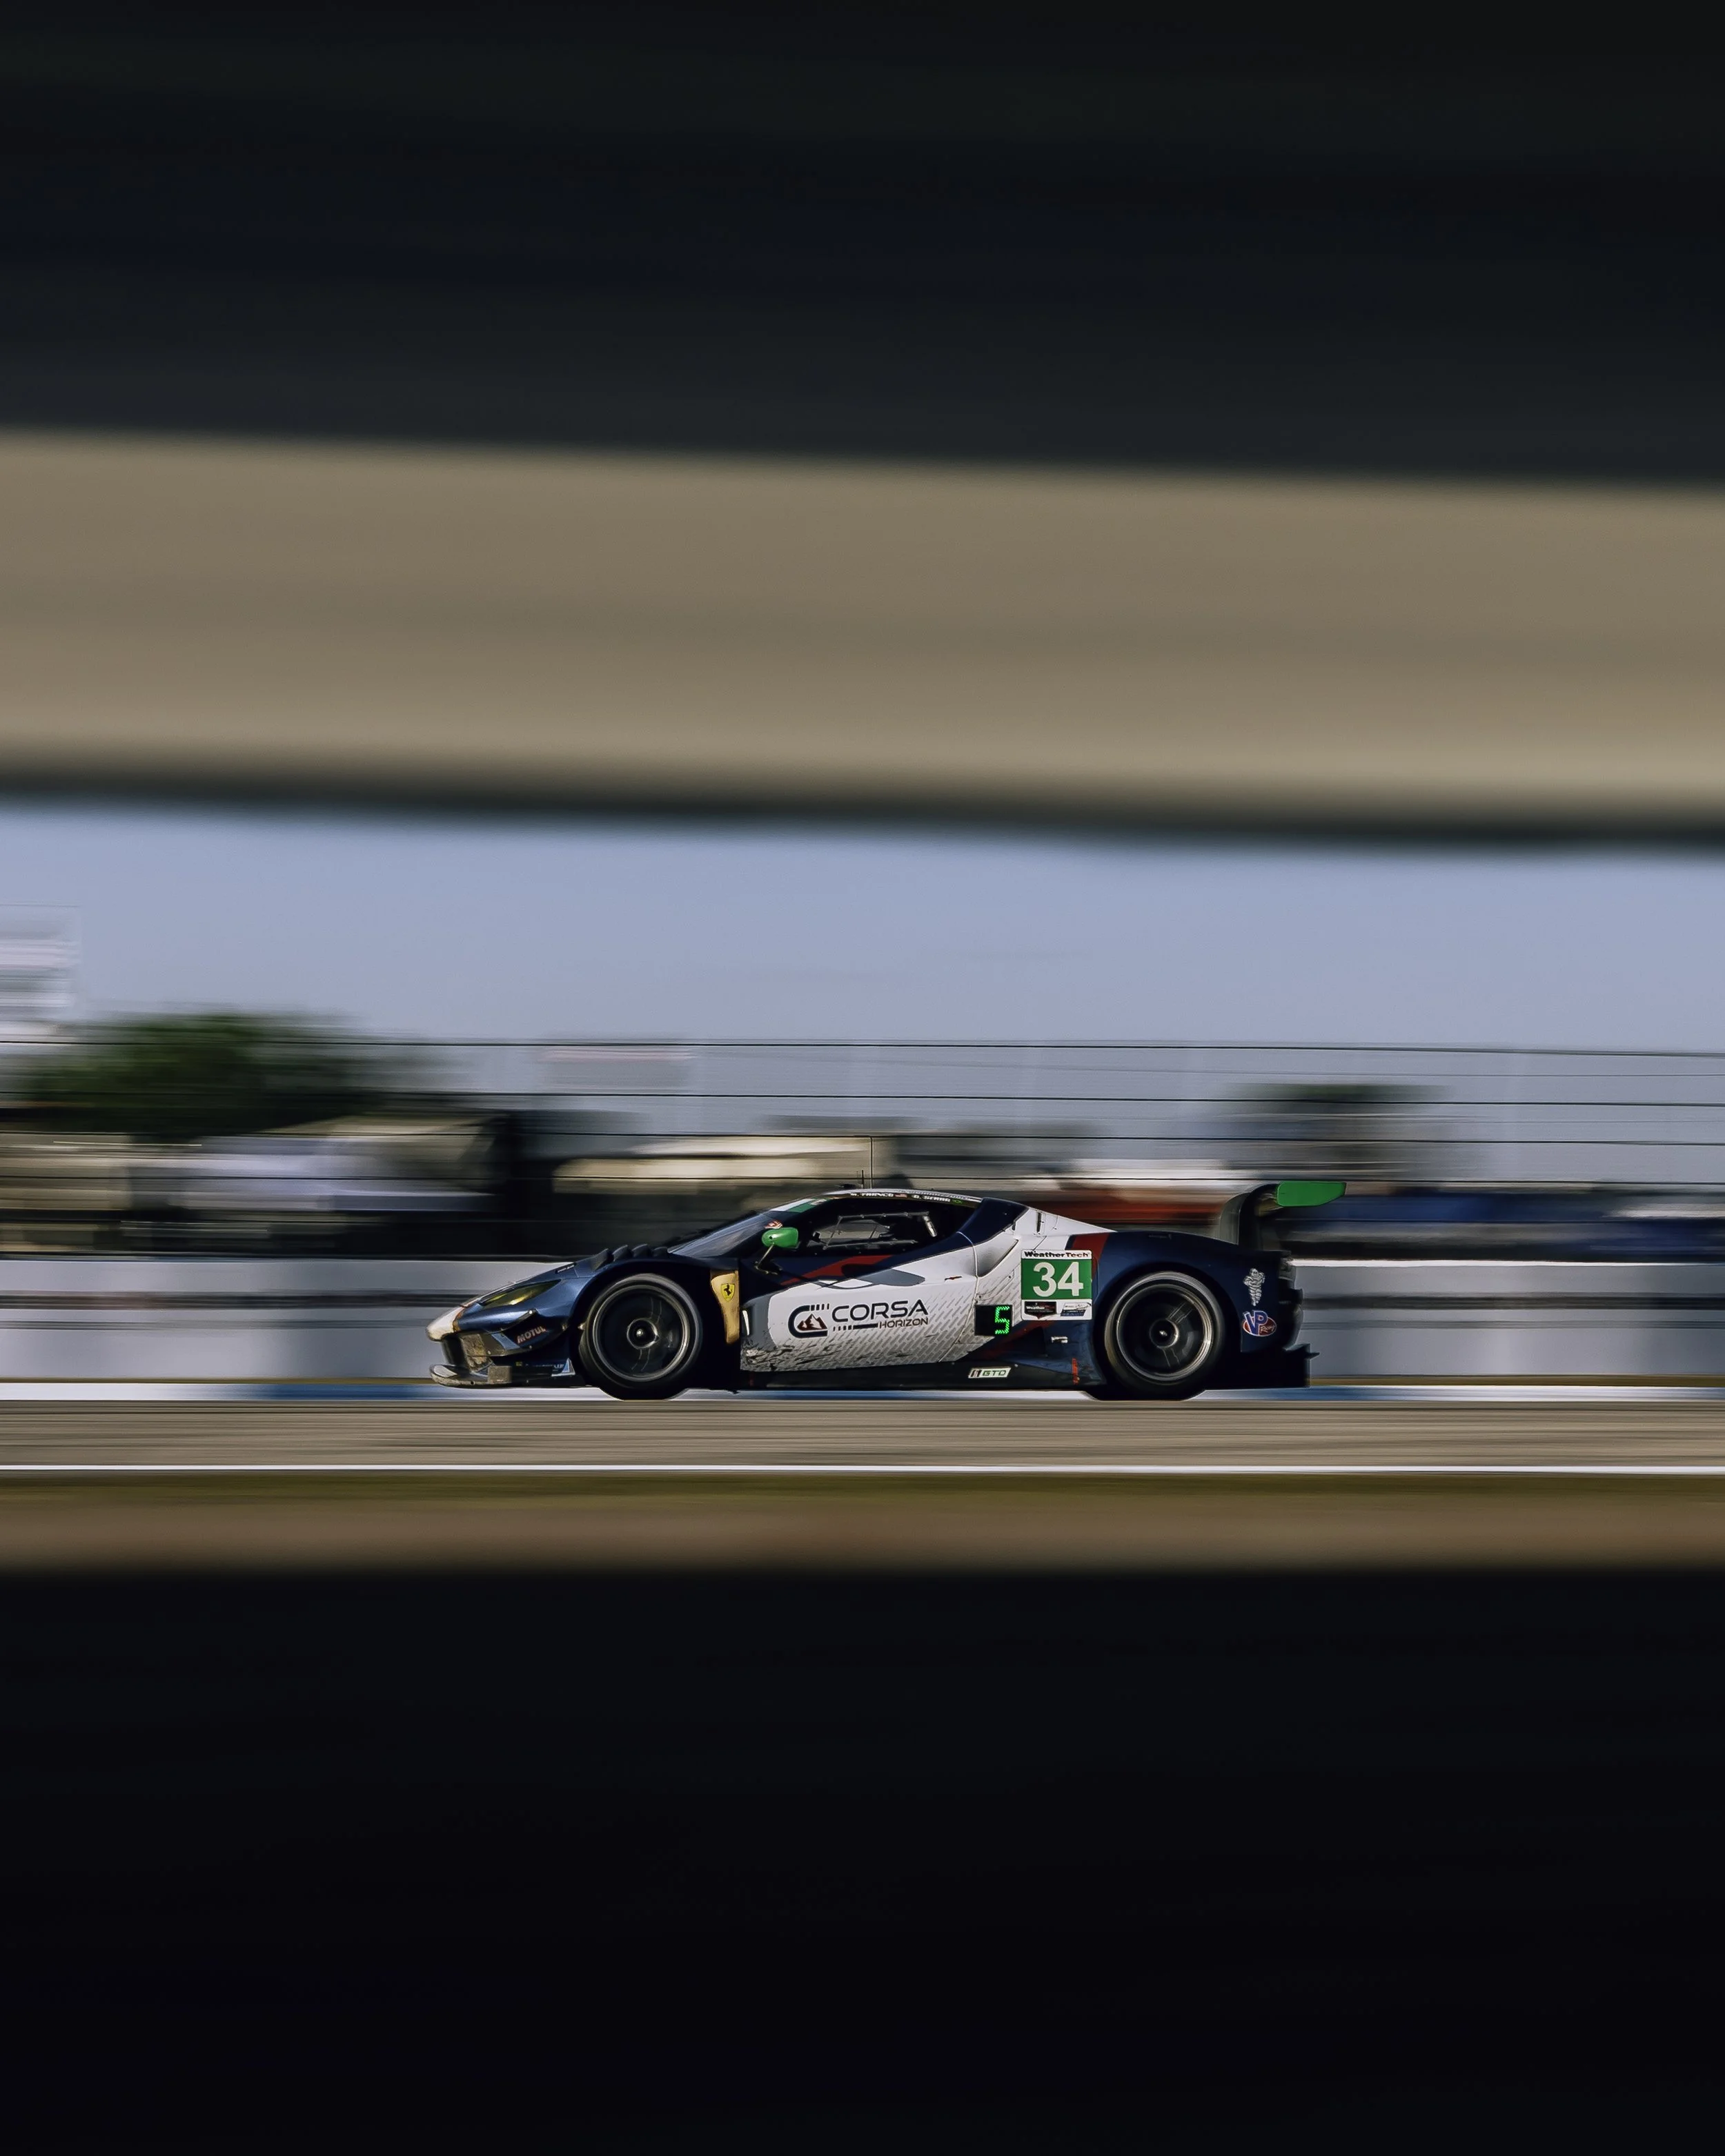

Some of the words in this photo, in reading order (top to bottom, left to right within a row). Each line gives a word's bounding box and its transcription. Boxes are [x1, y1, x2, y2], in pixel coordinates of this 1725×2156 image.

[1032, 1261, 1084, 1297] 34
[831, 1299, 929, 1323] CORSA
[879, 1316, 929, 1329] HORIZON
[1243, 1310, 1268, 1336] VP
[517, 1326, 546, 1343] MOTUL
